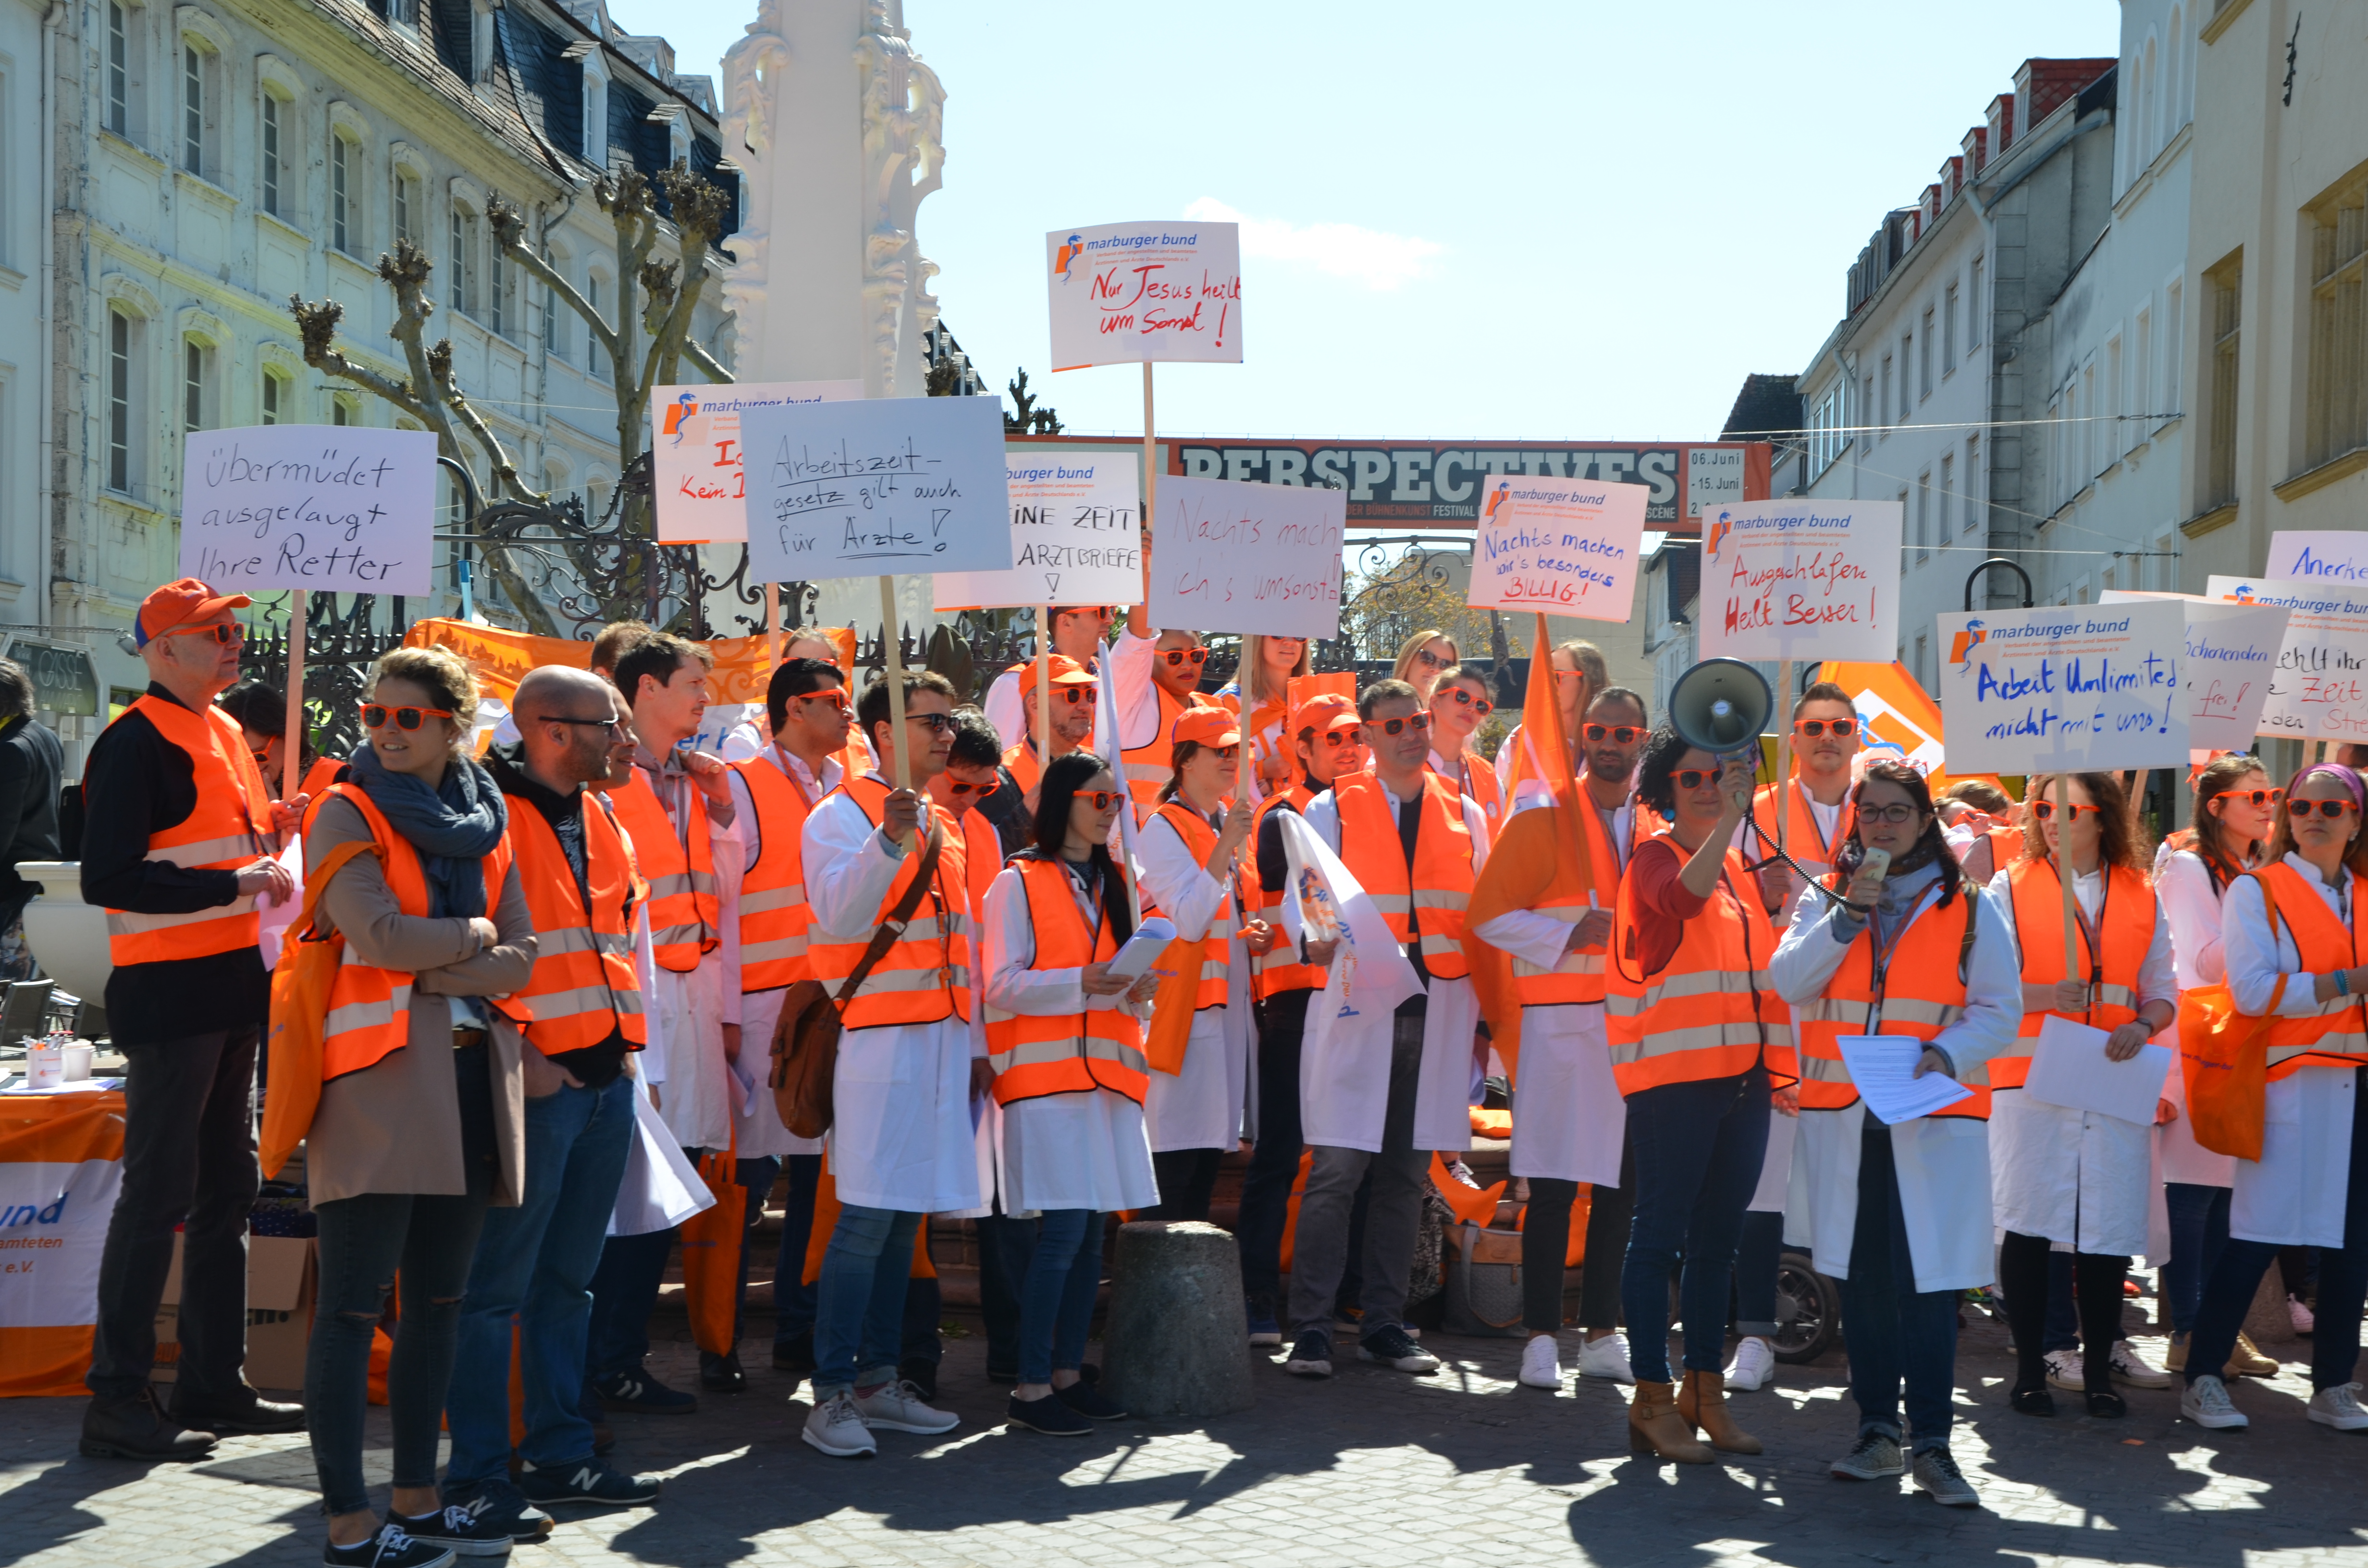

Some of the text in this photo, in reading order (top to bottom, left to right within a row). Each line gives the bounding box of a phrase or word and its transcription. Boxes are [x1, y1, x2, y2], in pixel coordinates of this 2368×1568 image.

[1087, 233, 1197, 250] marburger bund
[1090, 264, 1241, 311] Nur Jesus heilt
[1100, 314, 1134, 334] um
[1056, 466, 1094, 479] bund
[678, 474, 727, 499] Kein
[1716, 477, 1739, 490] Juni
[774, 475, 962, 520] gesetz gilt auch
[1511, 489, 1606, 505] marburger bund
[202, 496, 387, 541] ausgelaugt
[1366, 502, 1431, 515] BÜHNENKUNST
[1433, 505, 1476, 516] FESTIVAL
[1646, 505, 1676, 519] SCÈNE
[1173, 496, 1337, 548] Nachts mach
[1734, 514, 1852, 530] marburger bund
[779, 524, 815, 555] für
[1484, 528, 1625, 562] Nachts machen
[198, 533, 403, 580] Ihre Retter
[1537, 553, 1615, 588] besonders
[2258, 596, 2341, 613] marburger
[1725, 595, 1773, 637] Heilt
[1991, 617, 2131, 639] marburger bund
[2337, 649, 2367, 670] ihr
[1977, 658, 2055, 702] Arbeit
[2271, 709, 2305, 729] den
[5, 1261, 34, 1273] e.V.
